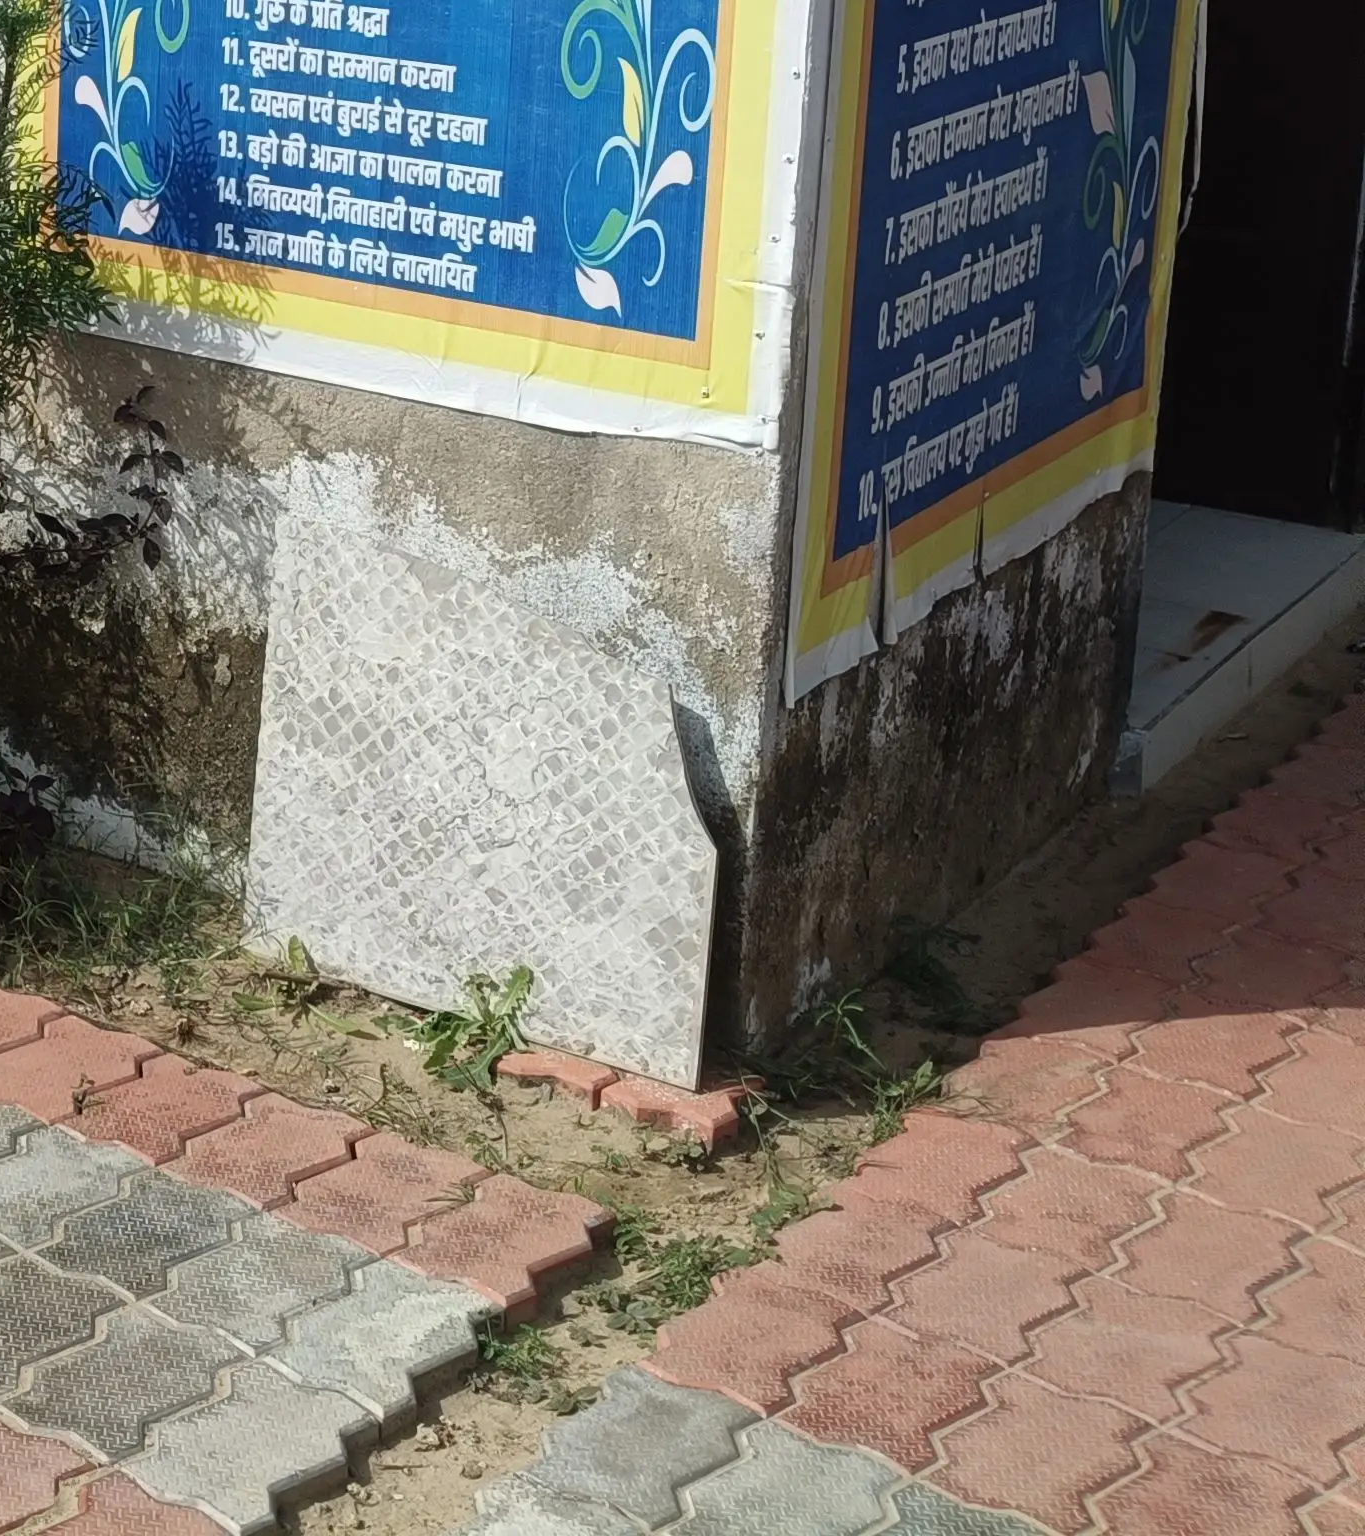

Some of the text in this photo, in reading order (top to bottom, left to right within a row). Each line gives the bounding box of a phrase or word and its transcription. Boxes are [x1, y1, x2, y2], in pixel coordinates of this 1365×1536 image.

[347, 5, 389, 37] श्रद्धा
[222, 37, 456, 92] 11. दूसरों का सम्मान करना
[220, 84, 487, 146] 12. व्यसन एवं बुराई से दूर रहना
[219, 130, 242, 159] 13.
[281, 133, 307, 168] की
[310, 144, 357, 175] आज्ञा
[359, 151, 385, 179] का
[386, 155, 444, 188] पालन
[445, 163, 503, 197] करना
[217, 176, 241, 205] 14.
[409, 202, 437, 236] एवं
[438, 211, 486, 252] मधुर
[489, 216, 536, 252] भाषी
[216, 223, 239, 251] 15.
[244, 228, 285, 258] ज्ञान
[327, 234, 347, 268] के
[349, 238, 390, 277] लिये
[392, 252, 477, 292] लालायित
